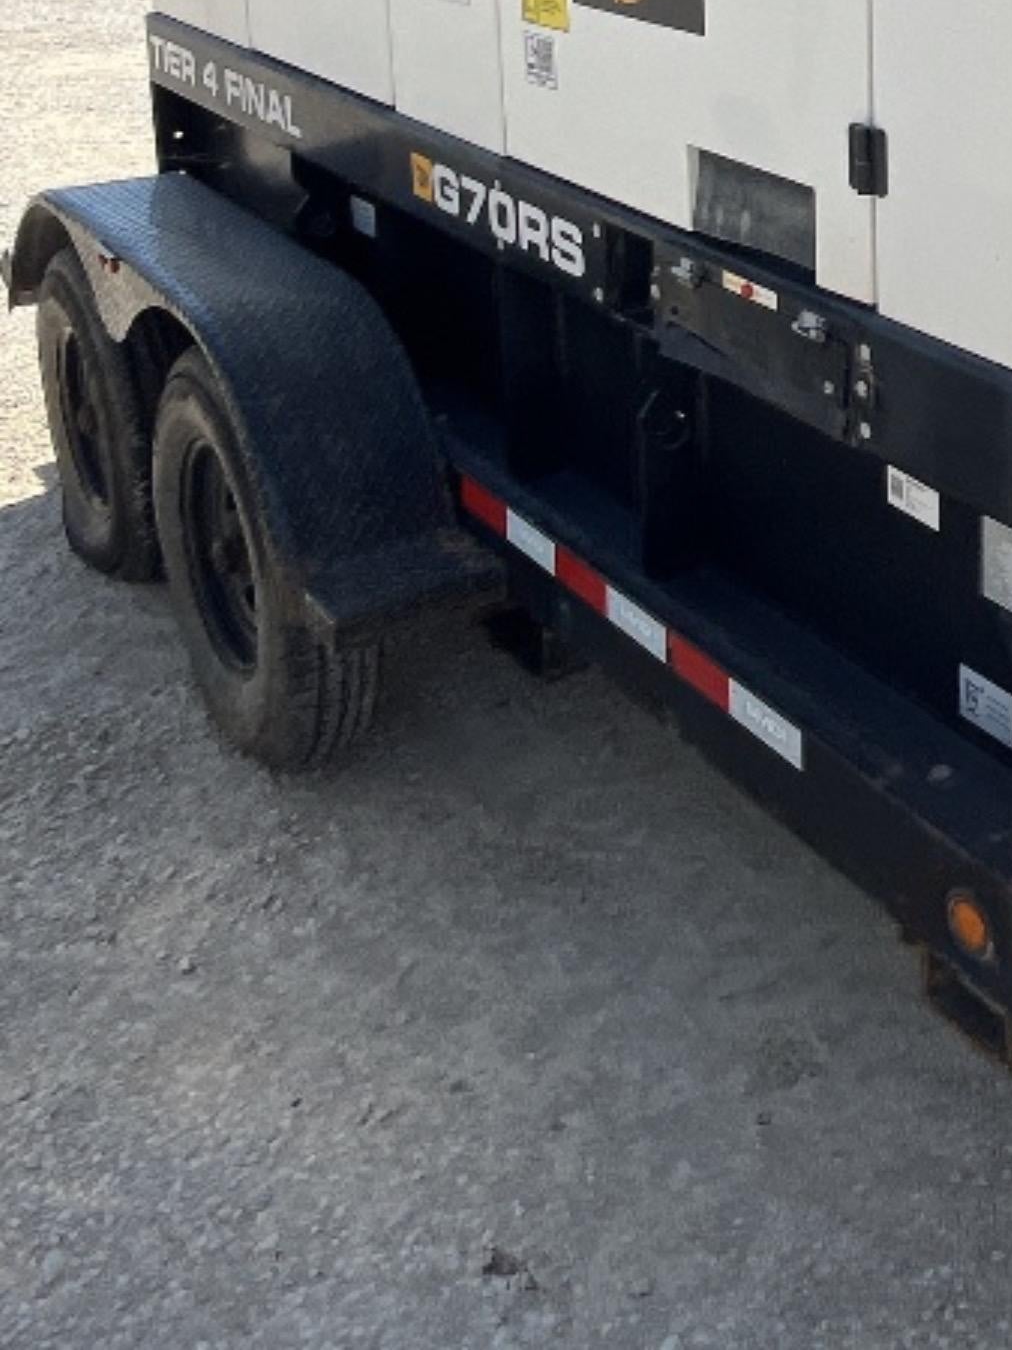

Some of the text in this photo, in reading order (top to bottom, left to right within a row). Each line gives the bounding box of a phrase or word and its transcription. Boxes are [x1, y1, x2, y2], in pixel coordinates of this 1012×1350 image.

[150, 34, 303, 139] TIER 4 FINAL
[433, 162, 586, 278] G70RS
